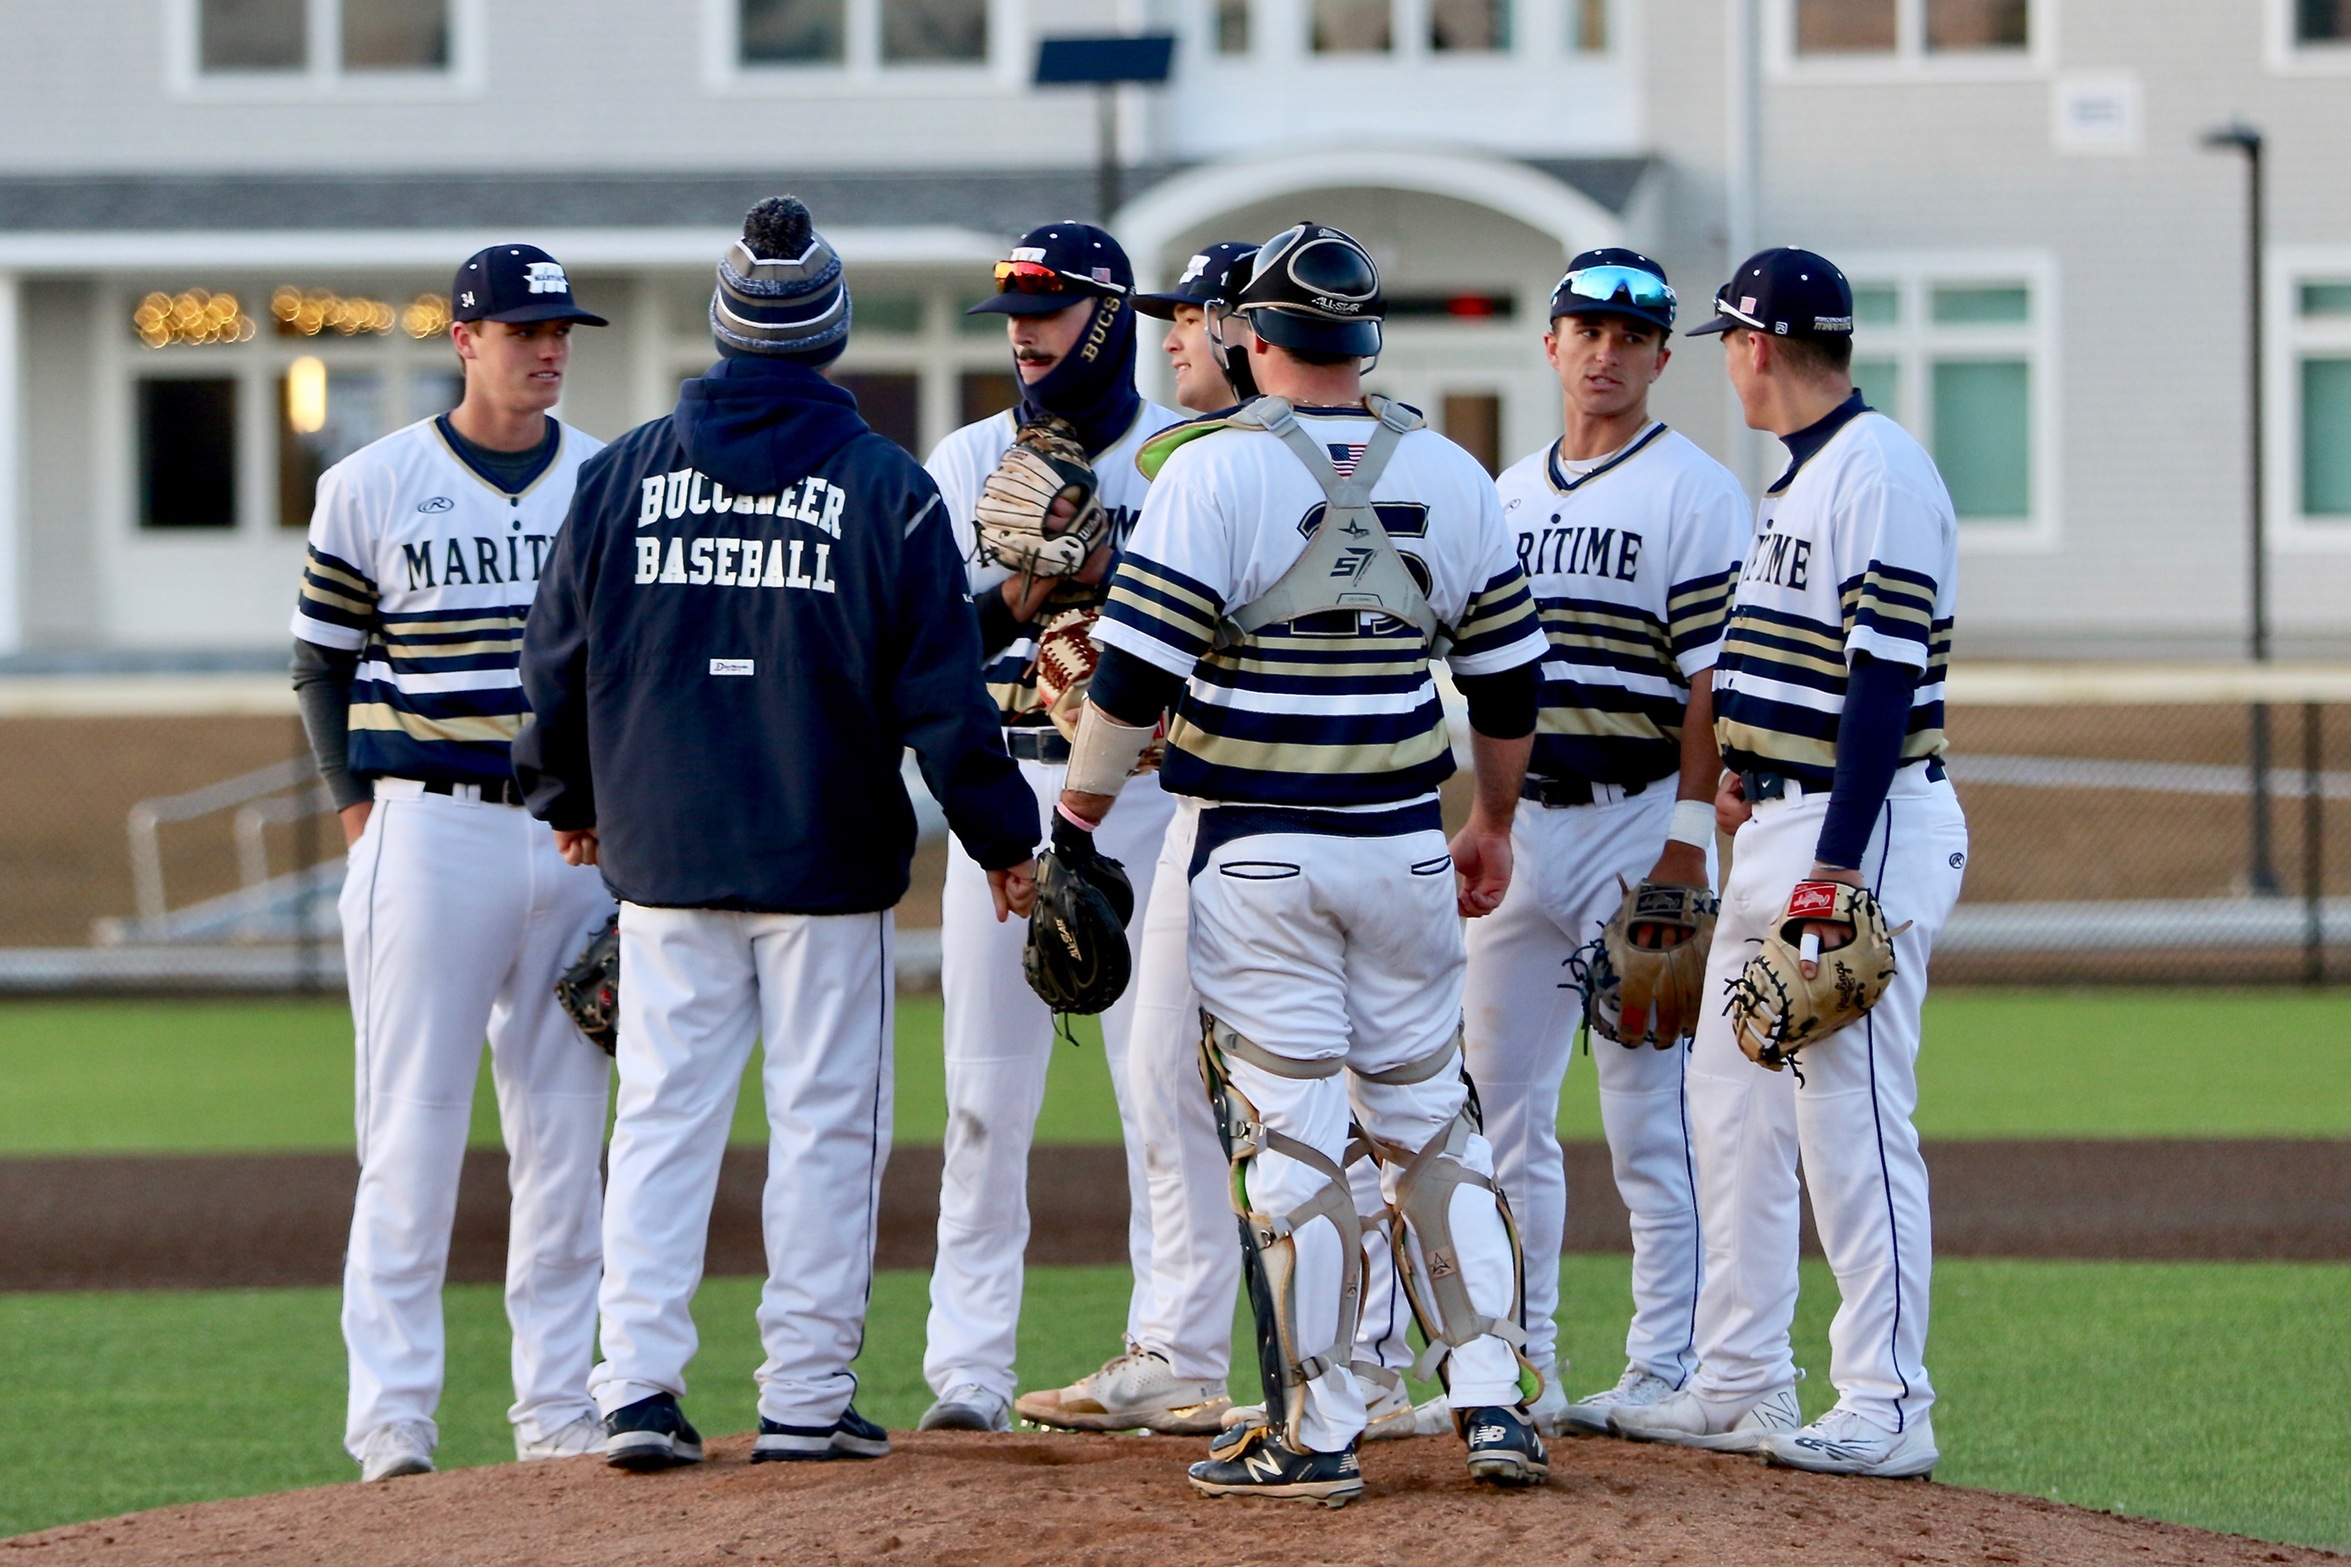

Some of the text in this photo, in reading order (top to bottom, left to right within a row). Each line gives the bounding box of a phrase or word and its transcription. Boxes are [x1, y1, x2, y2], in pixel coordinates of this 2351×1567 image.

[460, 291, 475, 308] 34
[1080, 296, 1121, 363] BUCS
[401, 535, 556, 592] MARIT
[635, 537, 835, 593] BASEBALL
